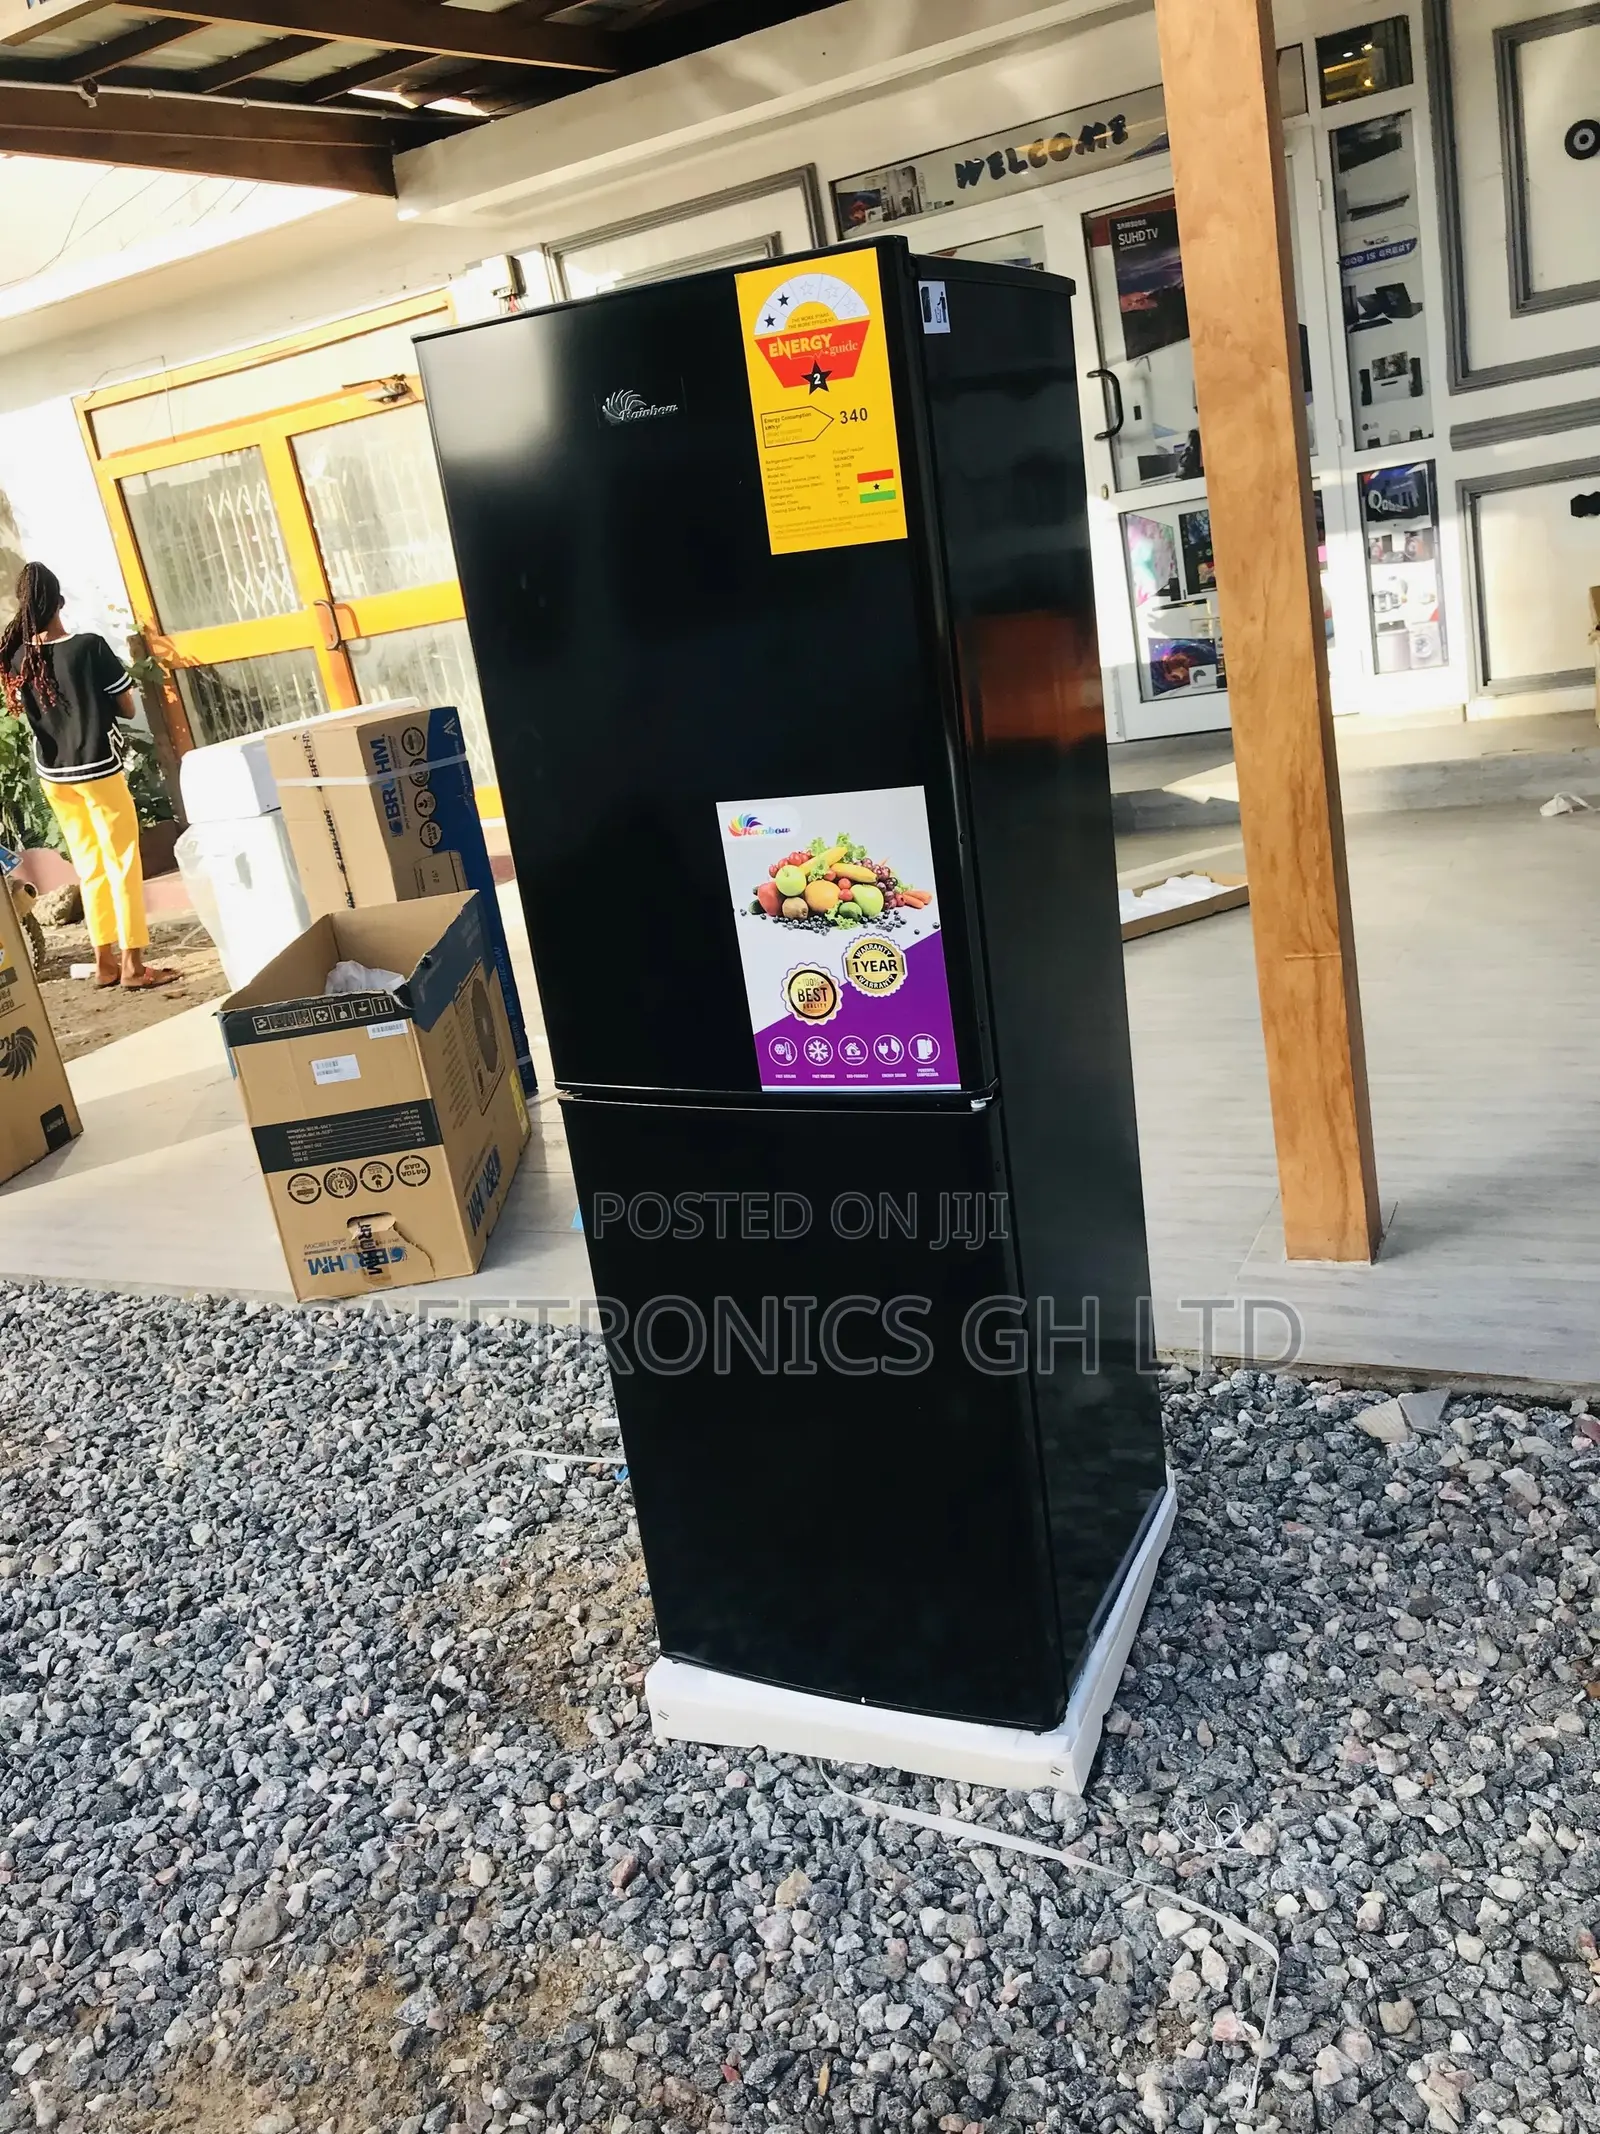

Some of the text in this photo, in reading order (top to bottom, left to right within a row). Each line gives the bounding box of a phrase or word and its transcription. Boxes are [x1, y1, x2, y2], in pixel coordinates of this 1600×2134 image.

[954, 113, 1128, 190] WELCOME
[1118, 227, 1159, 246] SUHD TV
[1366, 251, 1376, 261] IS
[1378, 243, 1411, 257] GREAT
[768, 333, 859, 360] ENERGY guide
[813, 373, 822, 385] 2
[764, 407, 868, 425] Energy Consumption 340
[741, 827, 792, 837] Rainbow
[854, 942, 892, 958] WARRANTY
[852, 959, 898, 973] 1 YEAR
[858, 974, 896, 989] WARRANTY
[797, 987, 828, 1003] BEST
[401, 1168, 427, 1177] R410A
[404, 1163, 420, 1171] GAS
